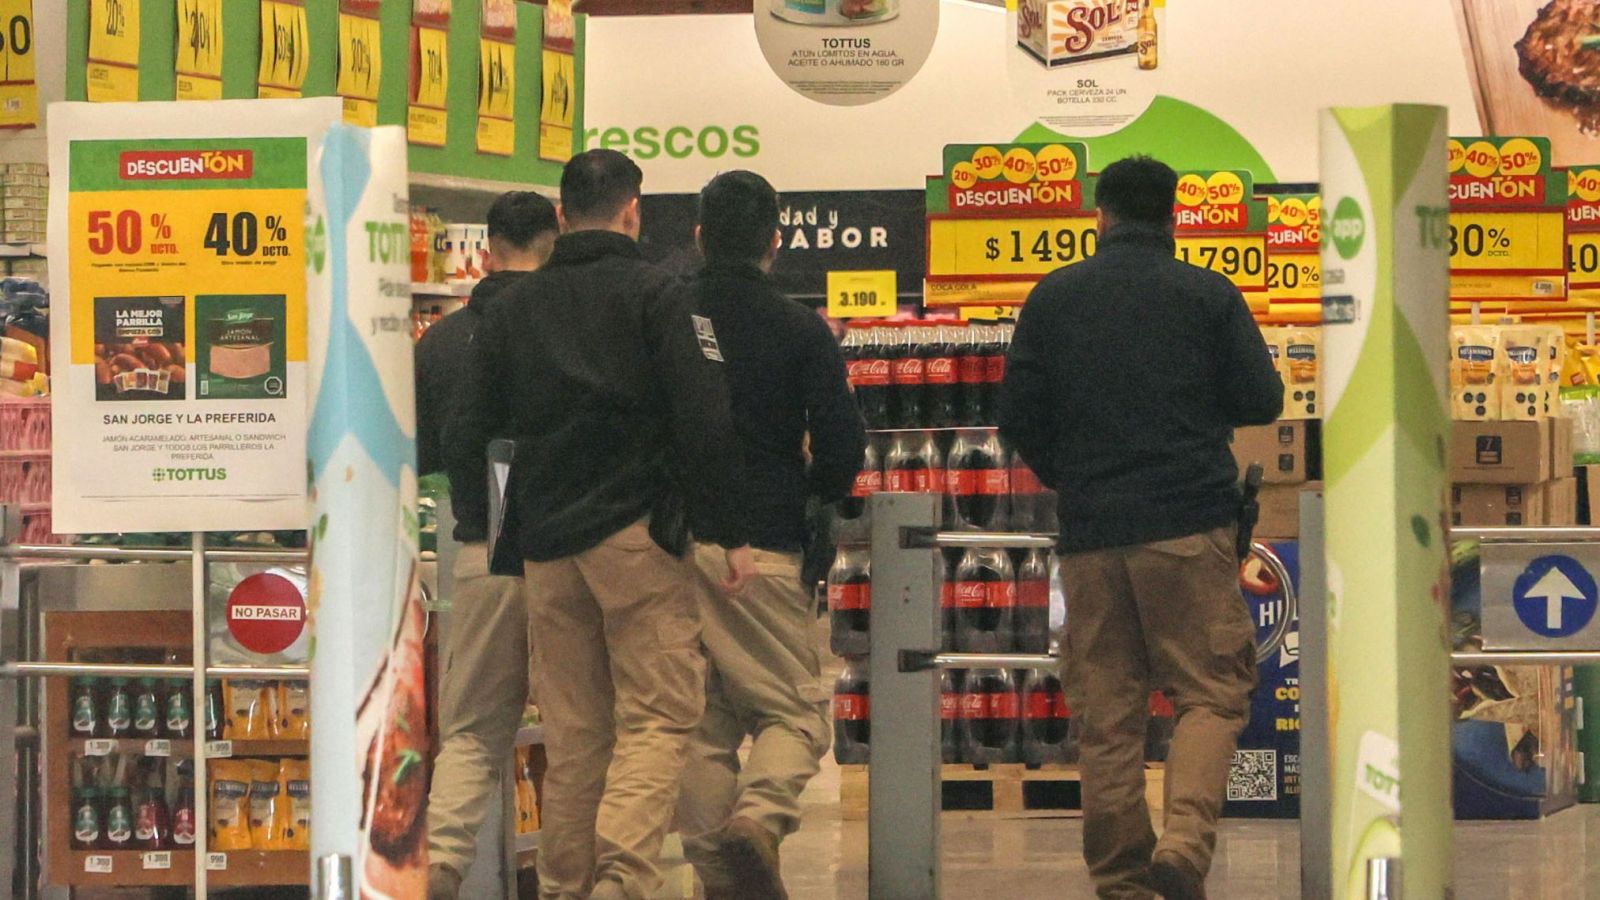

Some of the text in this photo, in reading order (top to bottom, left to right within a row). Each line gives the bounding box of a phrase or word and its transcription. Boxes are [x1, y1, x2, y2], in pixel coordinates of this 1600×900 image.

[0, 15, 30, 55] 0
[822, 38, 871, 48] TOTTUS
[788, 59, 819, 67] ACEITE
[1077, 79, 1099, 89] SOL
[127, 152, 244, 177] DESCUENTÓN
[1577, 176, 1600, 192] 40
[956, 182, 1073, 206] DESCUENTÓN
[828, 210, 838, 229] y
[116, 309, 162, 318] LA MEJOR
[116, 318, 163, 327] PARRILLA
[103, 413, 276, 424] SAN JORGE Y LA PREFERIDA
[243, 433, 286, 441] SANDWICH
[130, 444, 156, 452] JORGE
[165, 443, 191, 451] TODOS
[192, 443, 208, 451] LOS
[264, 442, 275, 450] LA
[166, 467, 227, 480] TOTTUS
[235, 608, 297, 618] NO PASAR
